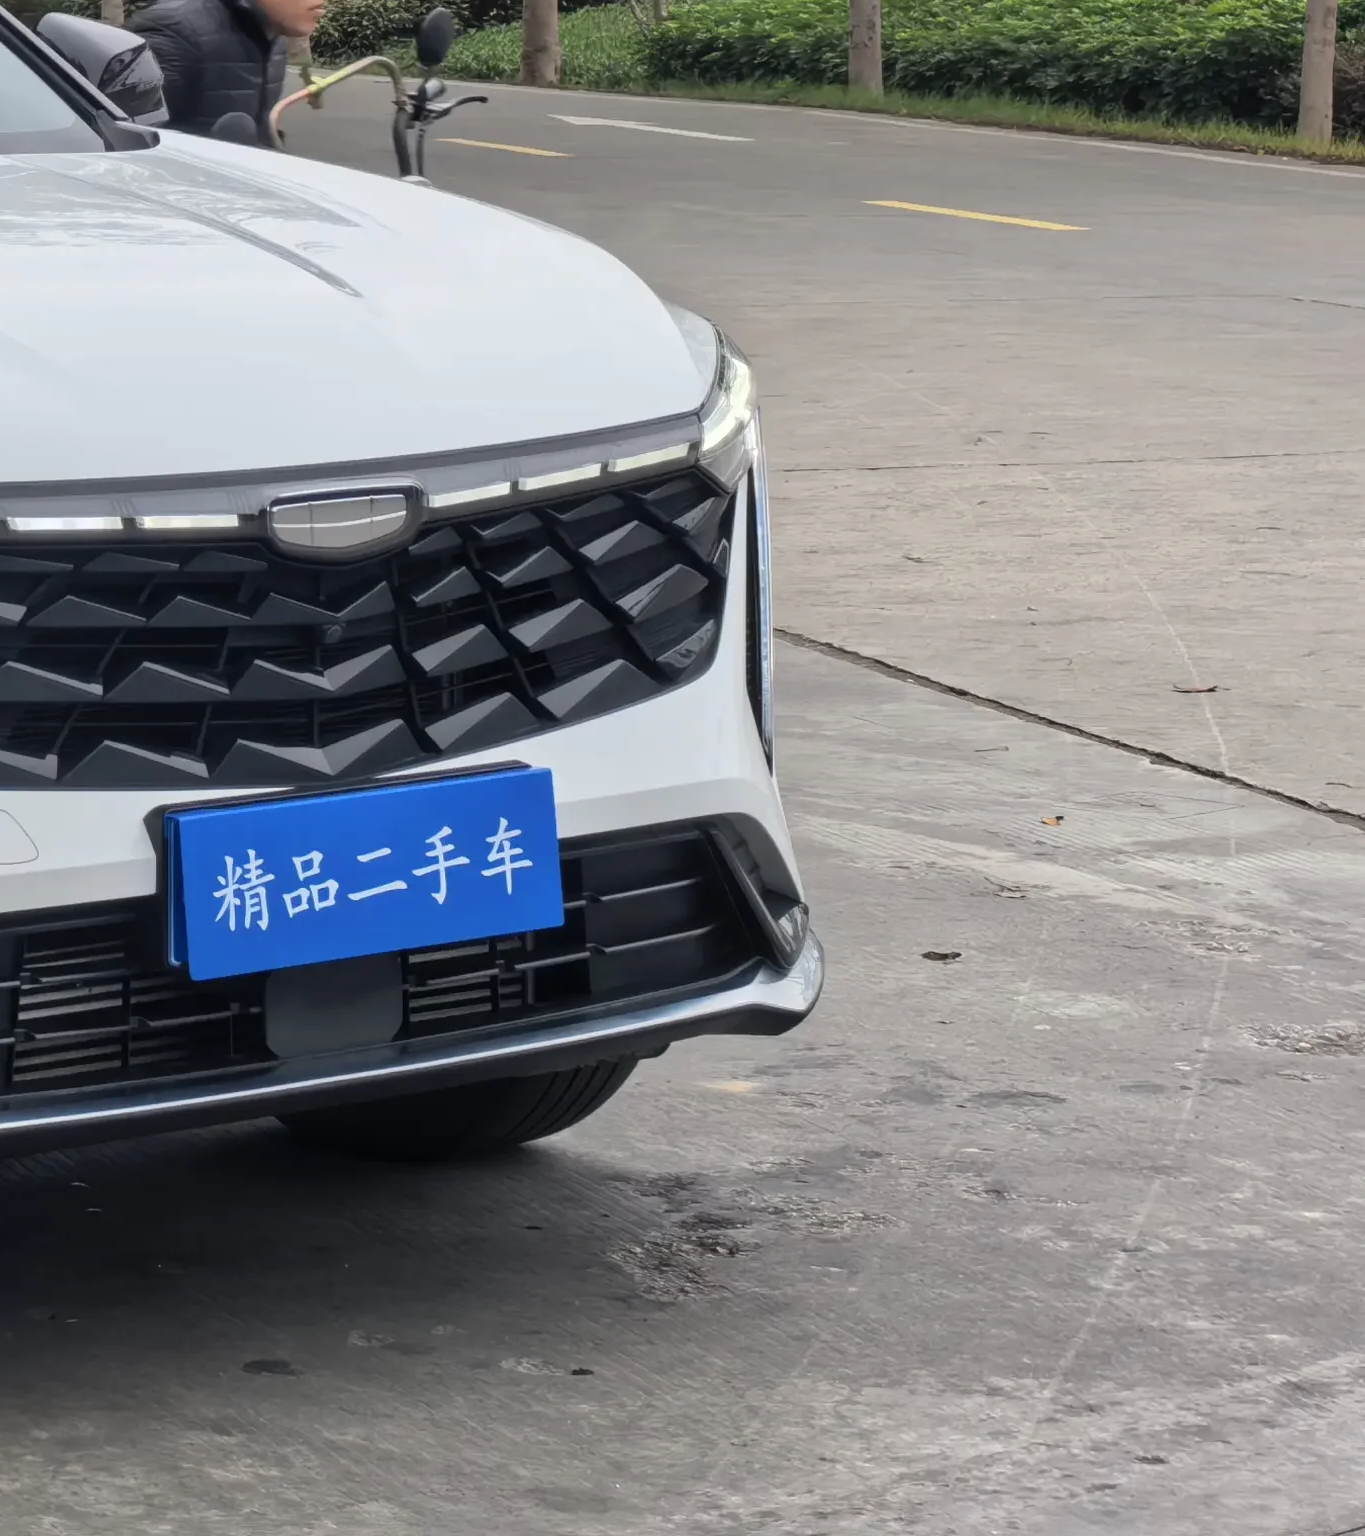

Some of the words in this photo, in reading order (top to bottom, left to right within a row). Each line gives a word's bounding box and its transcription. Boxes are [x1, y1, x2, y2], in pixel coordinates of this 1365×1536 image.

[212, 816, 533, 932] 精品二手车
